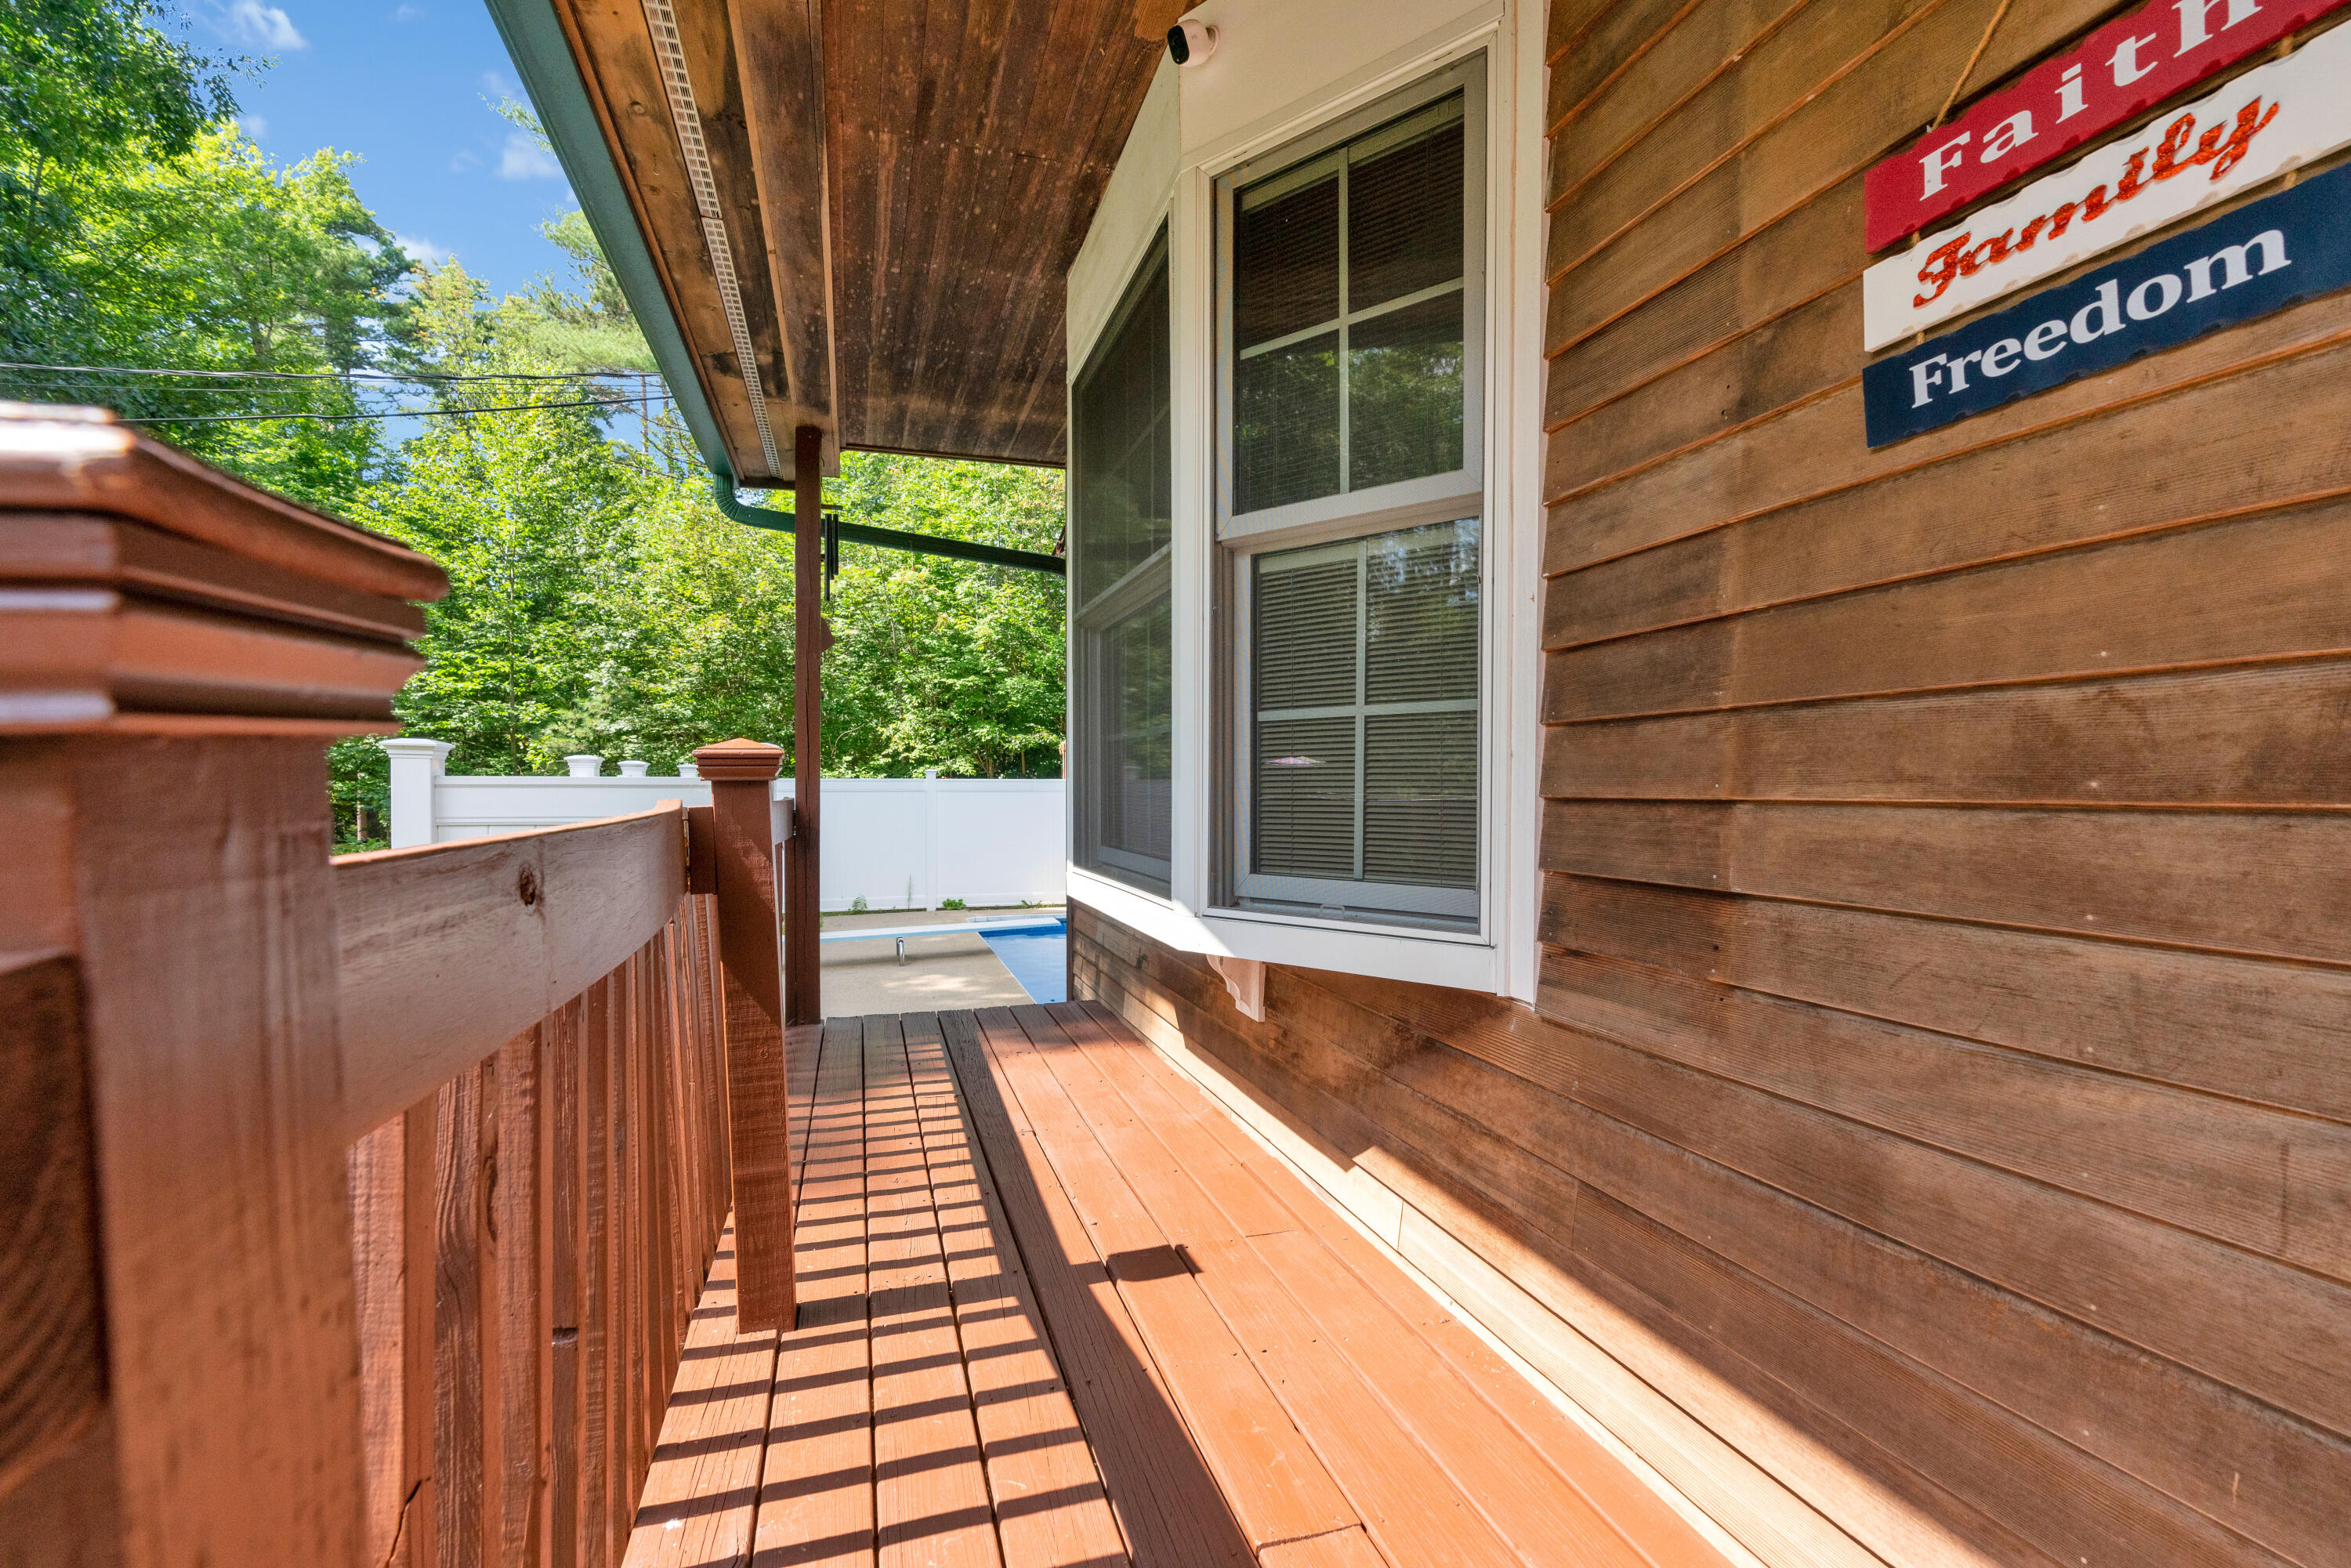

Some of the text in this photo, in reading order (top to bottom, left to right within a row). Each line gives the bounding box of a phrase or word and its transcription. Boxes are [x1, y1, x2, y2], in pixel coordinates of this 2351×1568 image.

[1918, 0, 2263, 201] Faith
[1912, 94, 2280, 310] Family
[1908, 228, 2292, 409] Freedom
